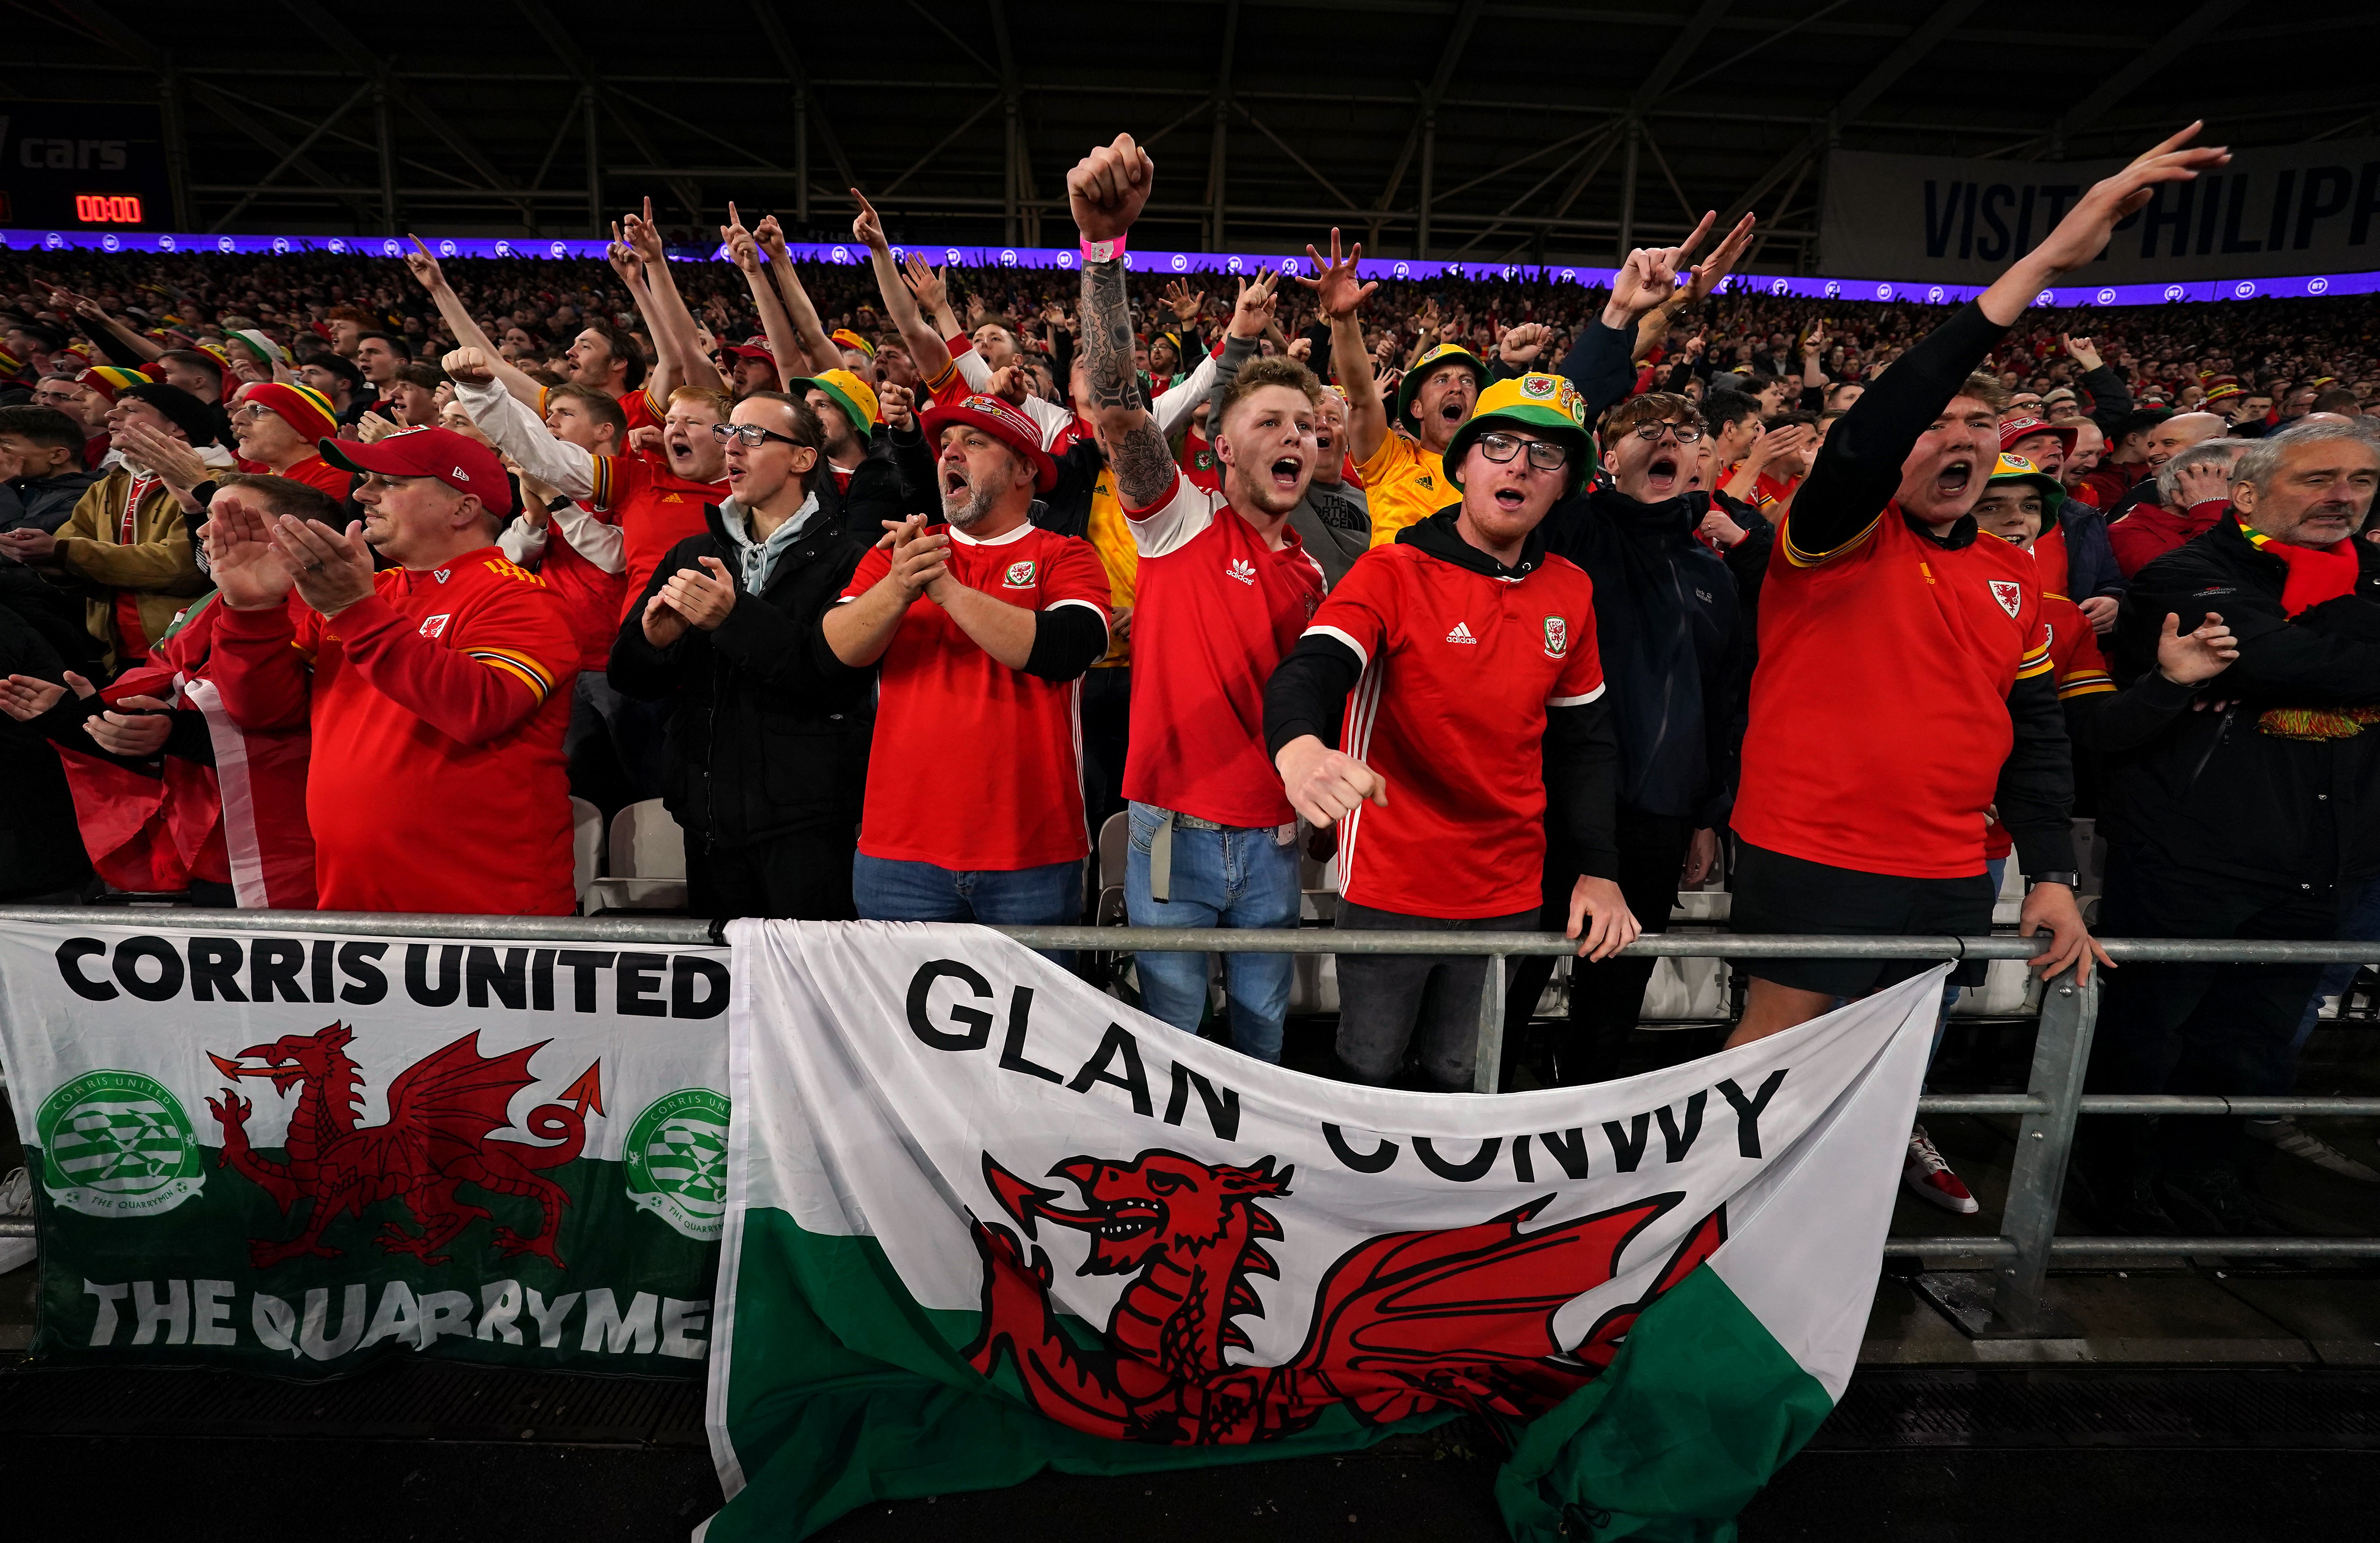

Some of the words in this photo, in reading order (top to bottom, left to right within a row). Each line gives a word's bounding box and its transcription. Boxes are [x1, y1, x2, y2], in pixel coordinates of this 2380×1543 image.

[19, 137, 128, 170] cars
[76, 195, 142, 223] 00:00
[1415, 479, 1434, 491] adidas
[1314, 506, 1347, 518] ORTH
[1323, 495, 1346, 507] THE
[1226, 569, 1252, 586] adidas
[1446, 636, 1477, 644] adidas
[55, 935, 389, 1005] CORRIS
[405, 943, 731, 1020] UNITED
[906, 959, 1240, 1142] GLAN
[53, 1077, 108, 1110] CORRIS
[116, 1078, 170, 1104] UNITED
[650, 1095, 701, 1120] CORRIS
[91, 1196, 113, 1207] THE
[118, 1189, 174, 1209] QUARRYMEN
[669, 1206, 683, 1222] THE
[83, 1278, 237, 1346] THE
